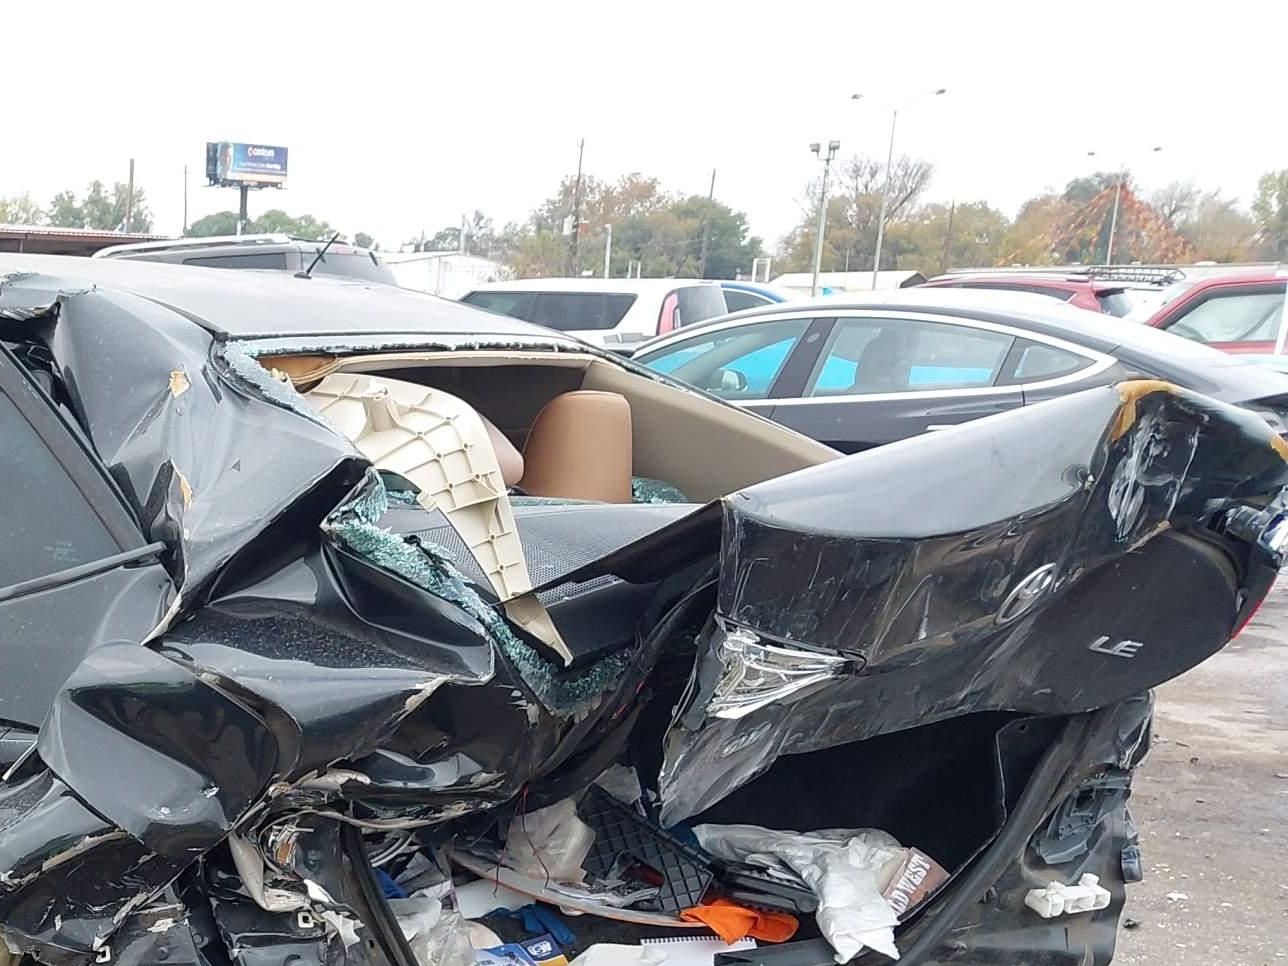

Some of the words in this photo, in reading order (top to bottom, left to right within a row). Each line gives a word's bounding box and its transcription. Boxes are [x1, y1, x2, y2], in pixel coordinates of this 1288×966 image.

[1088, 635, 1144, 658] LE
[895, 852, 932, 894] WEST
[886, 889, 910, 915] LD
